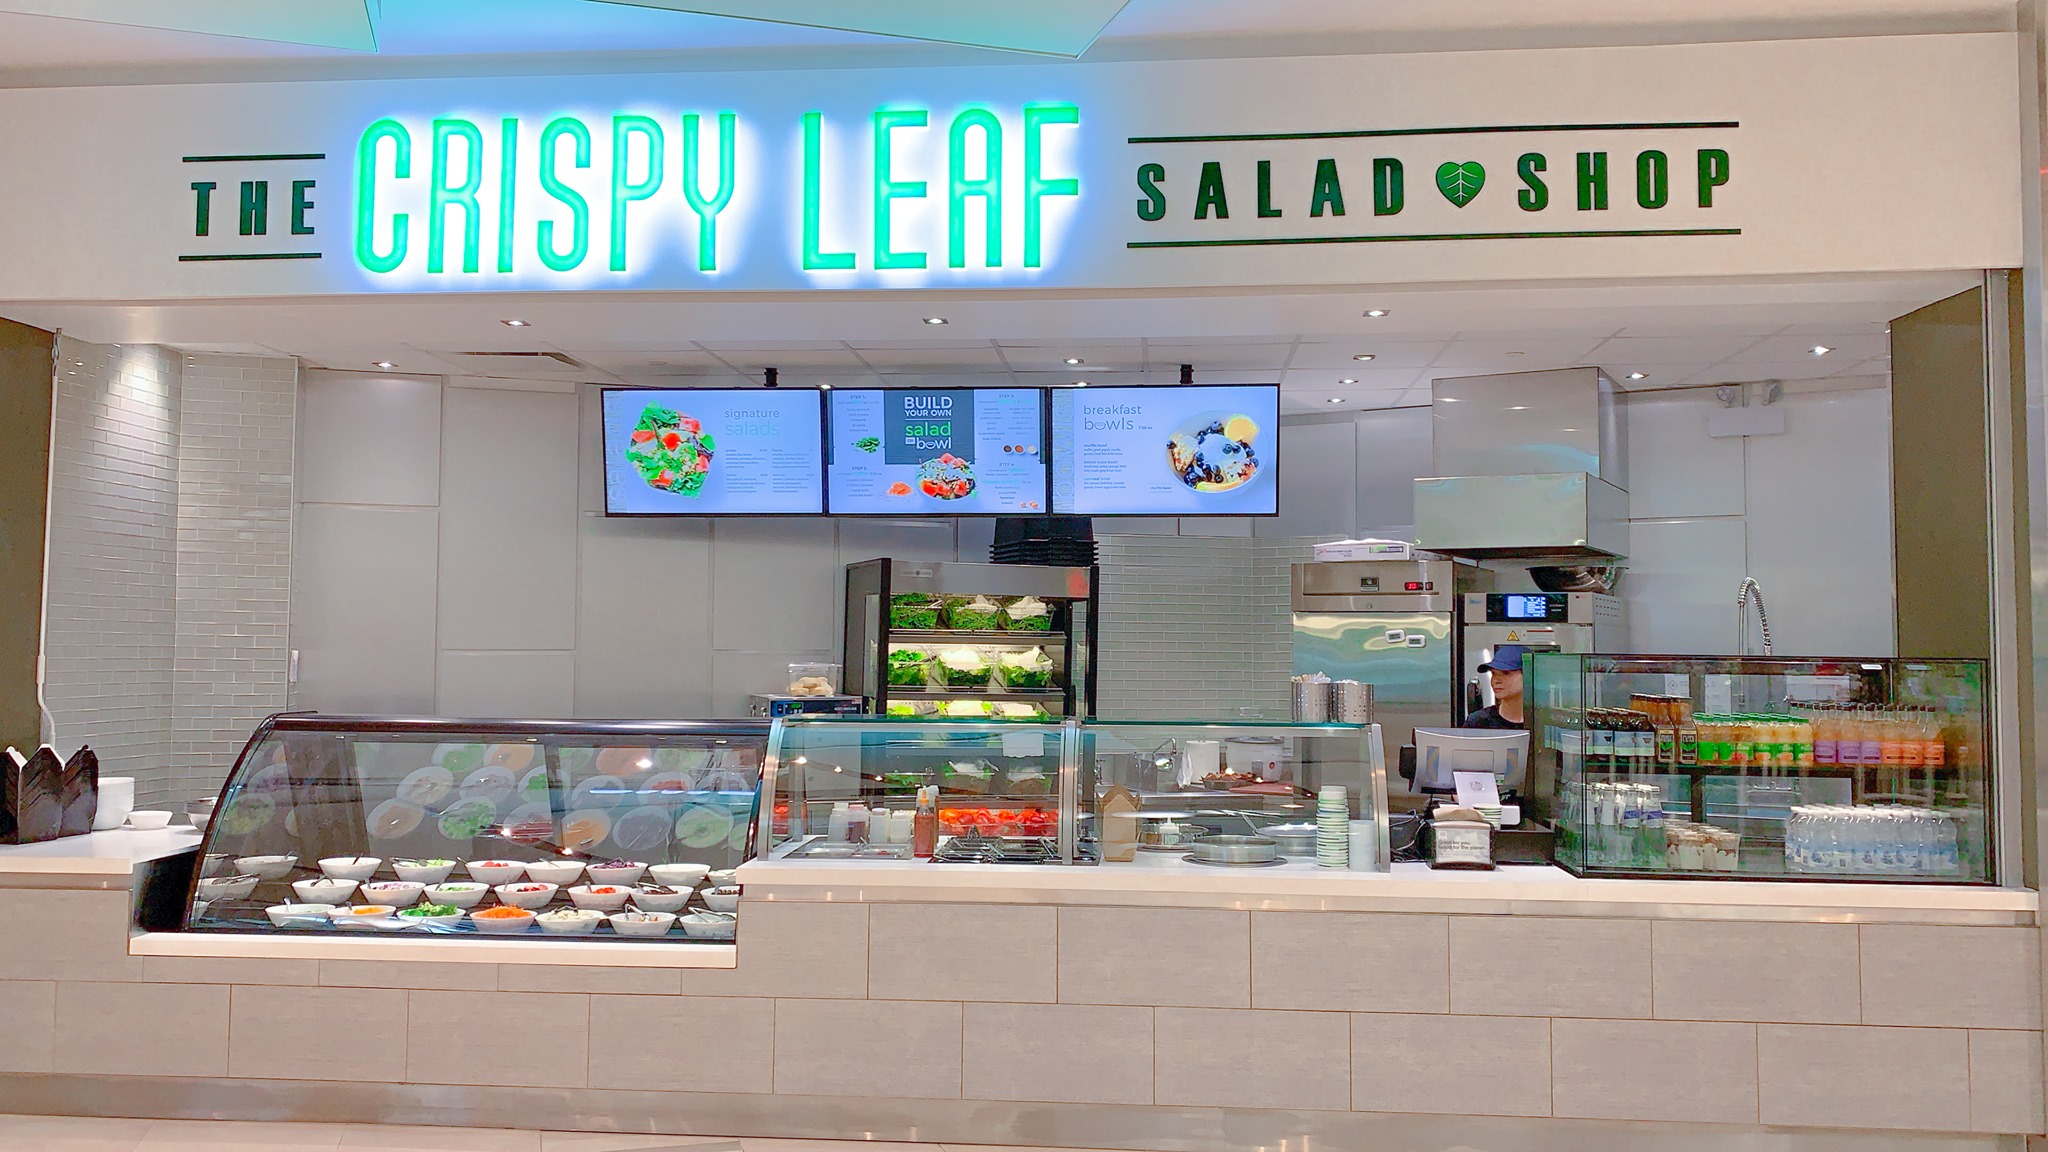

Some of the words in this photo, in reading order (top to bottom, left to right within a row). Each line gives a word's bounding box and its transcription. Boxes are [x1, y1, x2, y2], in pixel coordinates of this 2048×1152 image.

[356, 114, 736, 274] CRISPY
[803, 106, 1079, 270] LEAF
[1137, 157, 1404, 221] SALAD
[1517, 149, 1730, 211] SHOP
[191, 180, 316, 236] THE
[904, 396, 953, 409] BUILD
[1083, 404, 1142, 415] breakfast
[724, 409, 780, 420] signature
[904, 409, 929, 417] YOUR
[930, 409, 952, 417] OWN
[725, 421, 780, 436] salads
[905, 421, 951, 436] salad
[1084, 416, 1134, 430] bowls
[916, 436, 952, 450] bowl
